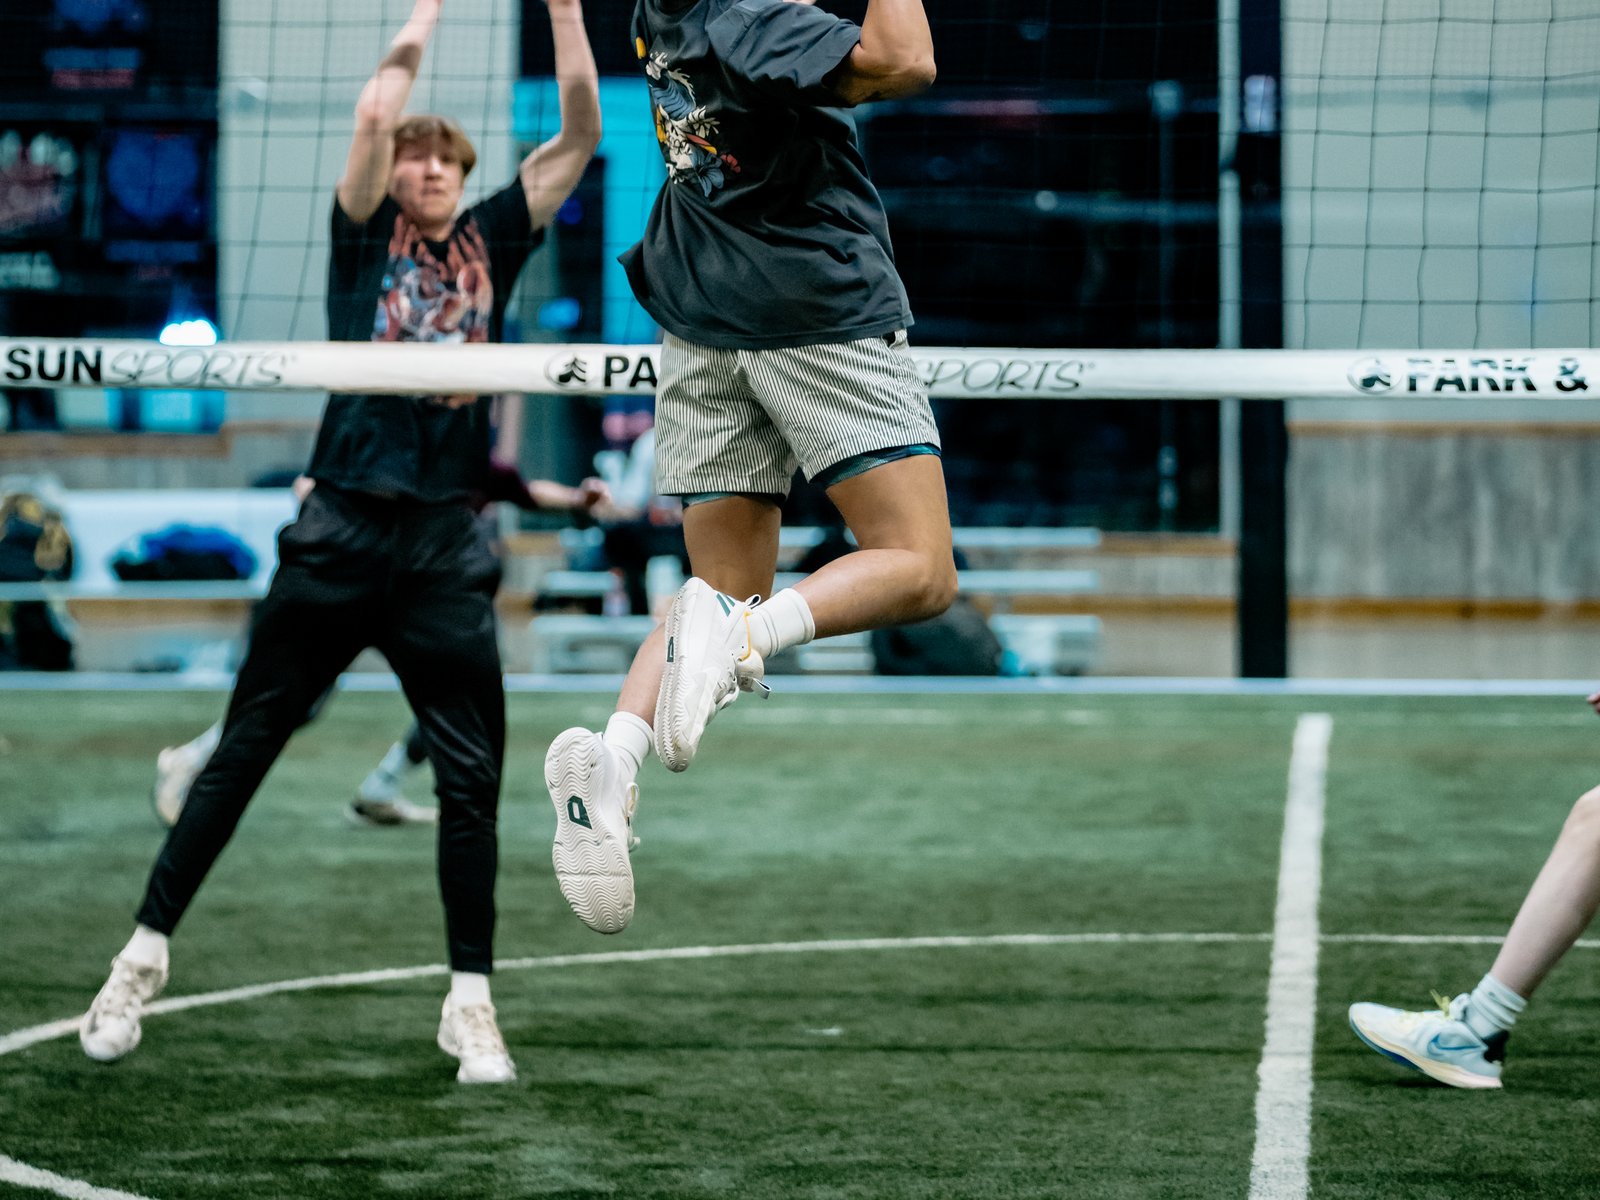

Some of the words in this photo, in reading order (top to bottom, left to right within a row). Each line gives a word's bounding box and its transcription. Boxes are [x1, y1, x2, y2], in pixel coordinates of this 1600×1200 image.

[5, 348, 102, 382] SUN
[111, 351, 289, 385] SPORTS
[604, 356, 658, 388] PA
[1407, 357, 1537, 392] PARK
